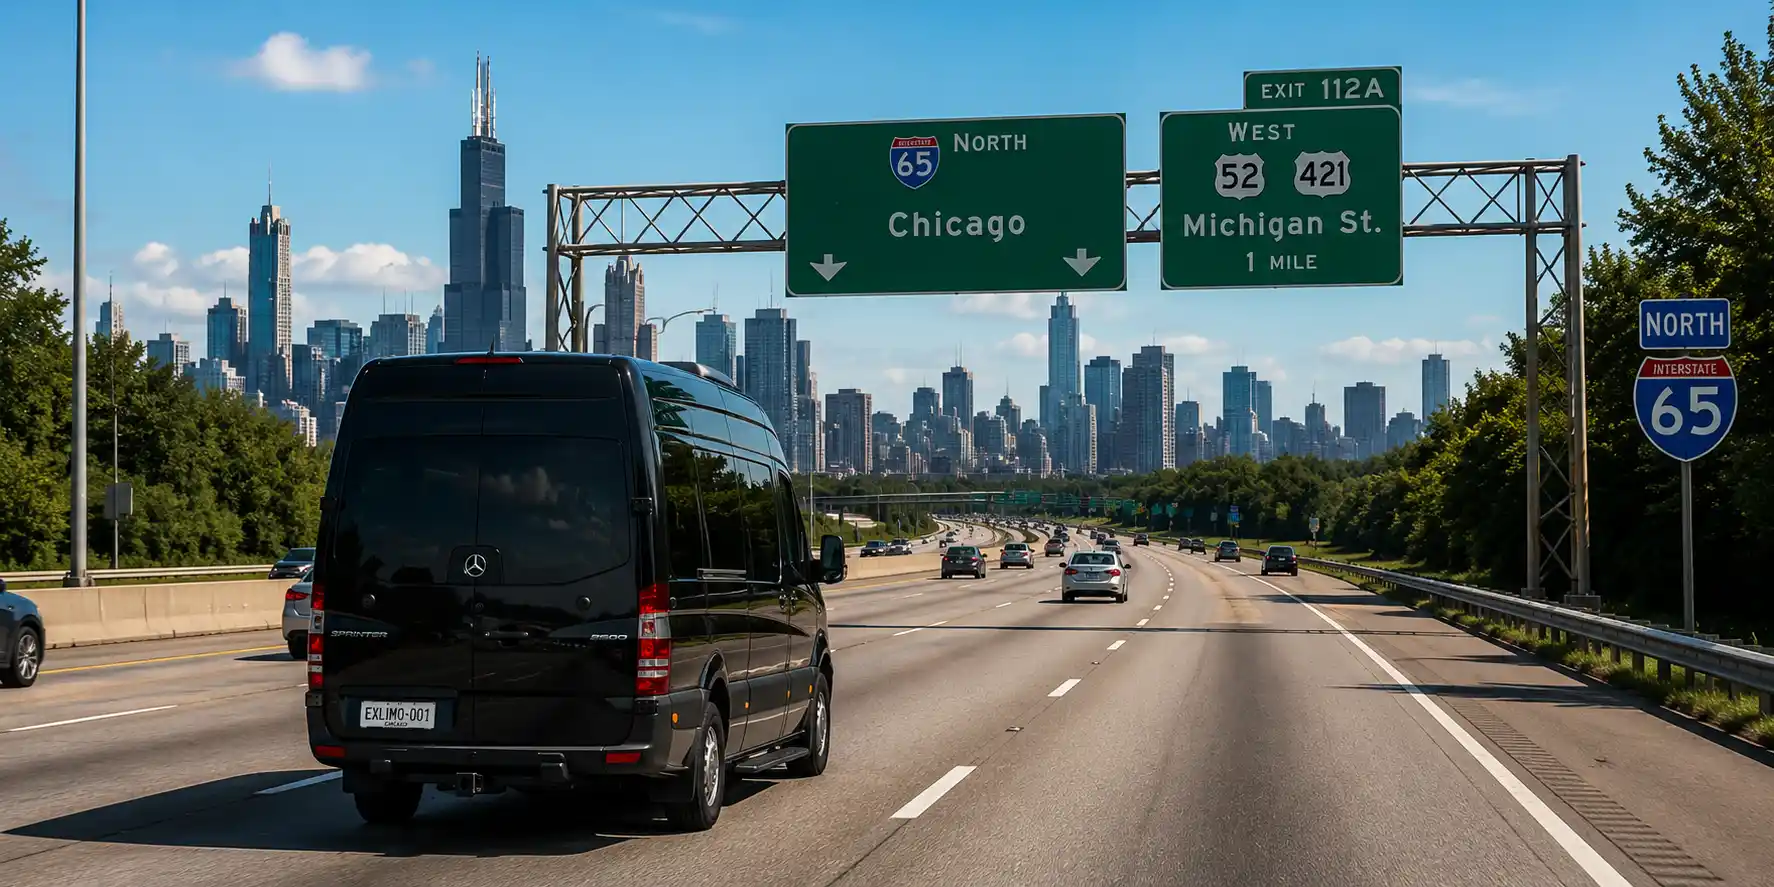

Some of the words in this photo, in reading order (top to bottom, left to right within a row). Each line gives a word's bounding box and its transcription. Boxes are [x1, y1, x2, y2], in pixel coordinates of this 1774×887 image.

[1261, 82, 1305, 99] EXIT
[1321, 77, 1384, 99] 112A
[953, 132, 1027, 152] NORTH
[1228, 122, 1295, 142] WEST
[897, 151, 932, 177] 65
[1299, 160, 1345, 188] 421
[1221, 162, 1258, 190] 52
[888, 210, 1026, 243] Chicago
[1183, 211, 1323, 242] Michigan
[1339, 209, 1382, 234] St.
[1246, 251, 1254, 272] 1
[1270, 254, 1317, 270] MILE
[1646, 312, 1724, 337] NORTH
[1653, 363, 1717, 375] INTERSTATE
[1651, 386, 1722, 436] 65
[330, 630, 389, 638] SPRINTER
[364, 706, 430, 722] EXLIMO-001
